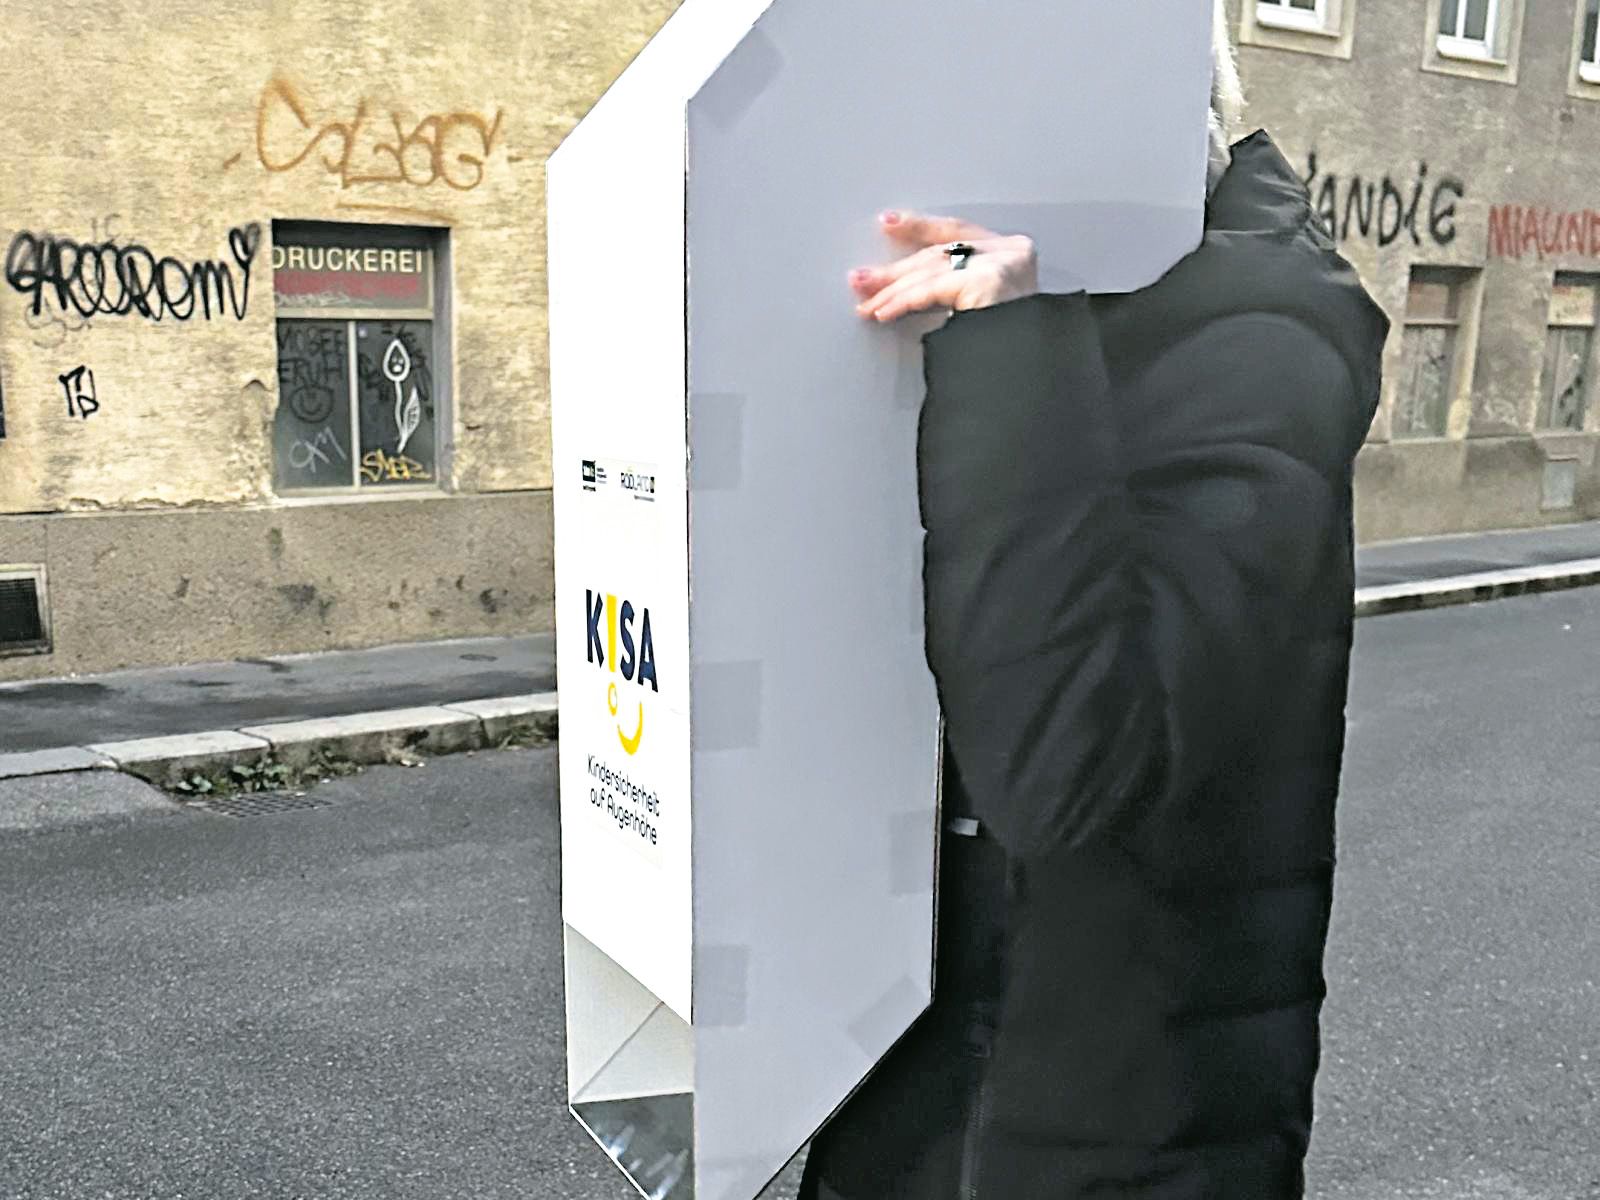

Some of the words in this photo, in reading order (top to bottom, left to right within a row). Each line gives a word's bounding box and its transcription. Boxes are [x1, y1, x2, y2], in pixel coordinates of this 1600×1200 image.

[272, 245, 423, 273] DRUCKEREI
[587, 753, 660, 817] Kindersicherheit
[590, 787, 606, 810] auf
[607, 793, 657, 845] Augenhöhe
